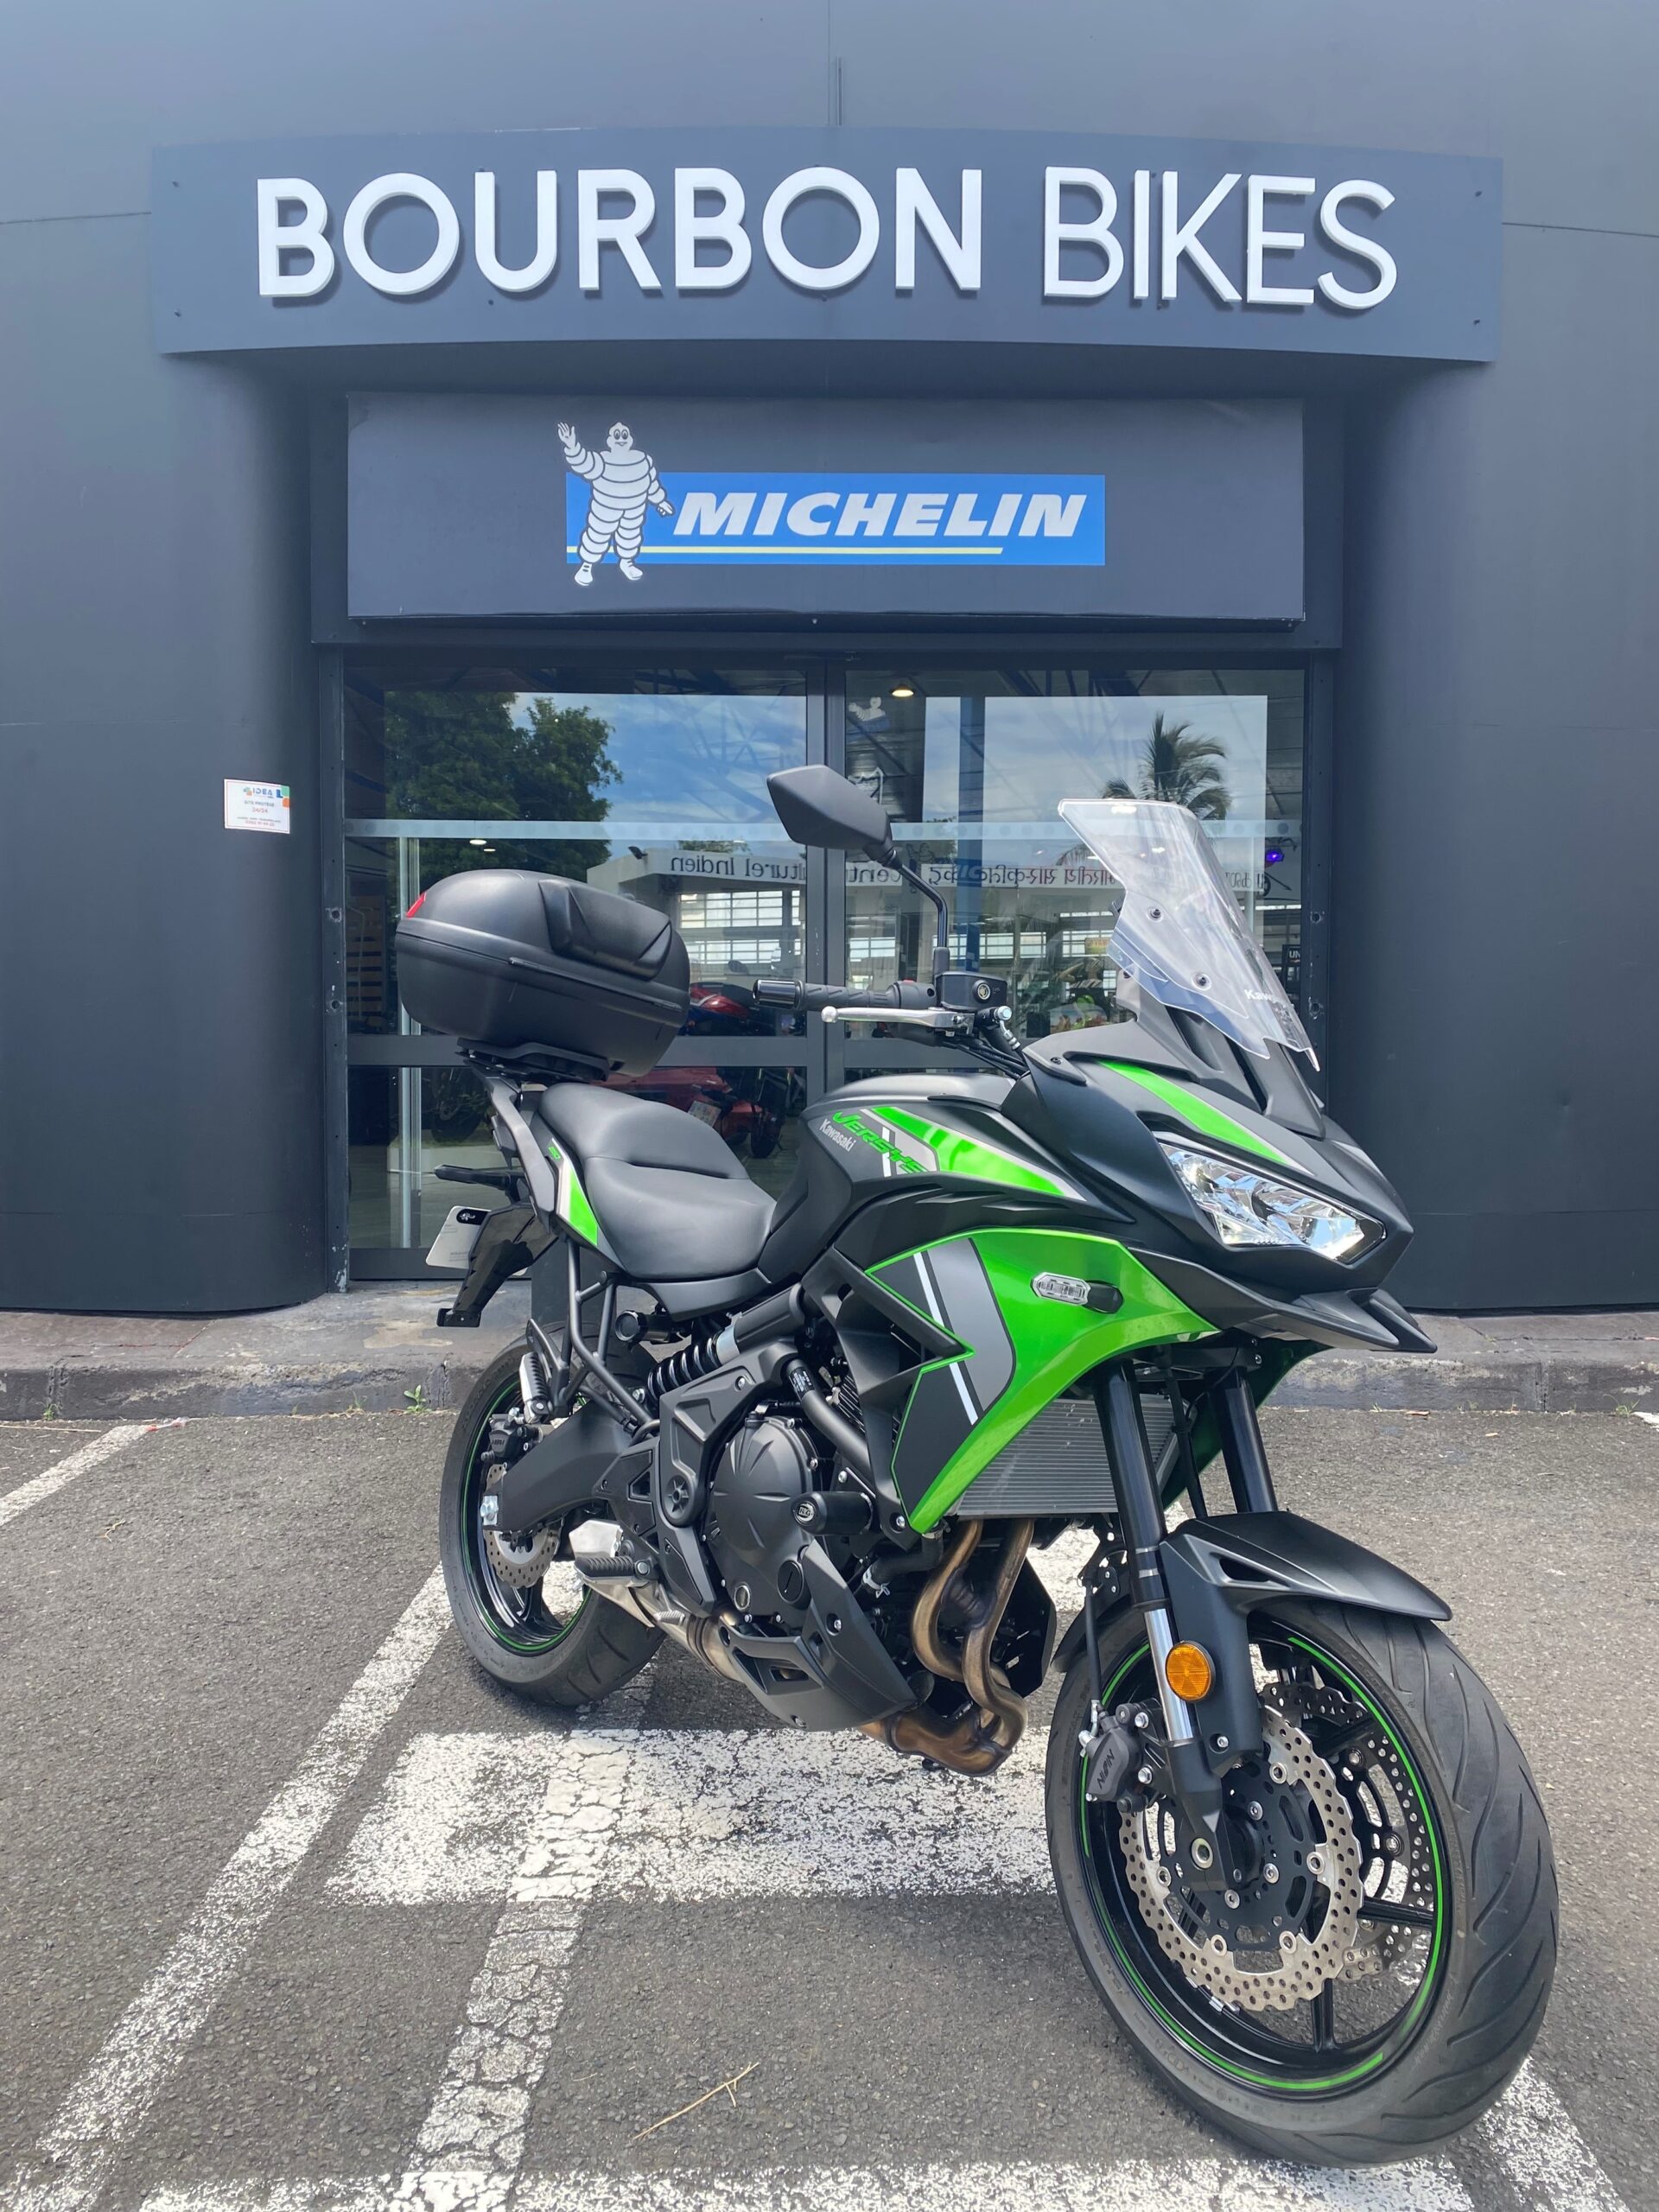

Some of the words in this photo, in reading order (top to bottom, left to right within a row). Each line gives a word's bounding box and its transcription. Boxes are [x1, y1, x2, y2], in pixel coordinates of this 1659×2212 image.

[257, 166, 982, 298] BOURBON
[1044, 166, 1398, 309] BIKES
[673, 492, 1087, 537] MICHELIN
[252, 787, 273, 796] IDEA
[819, 1118, 857, 1153] Kawasaki
